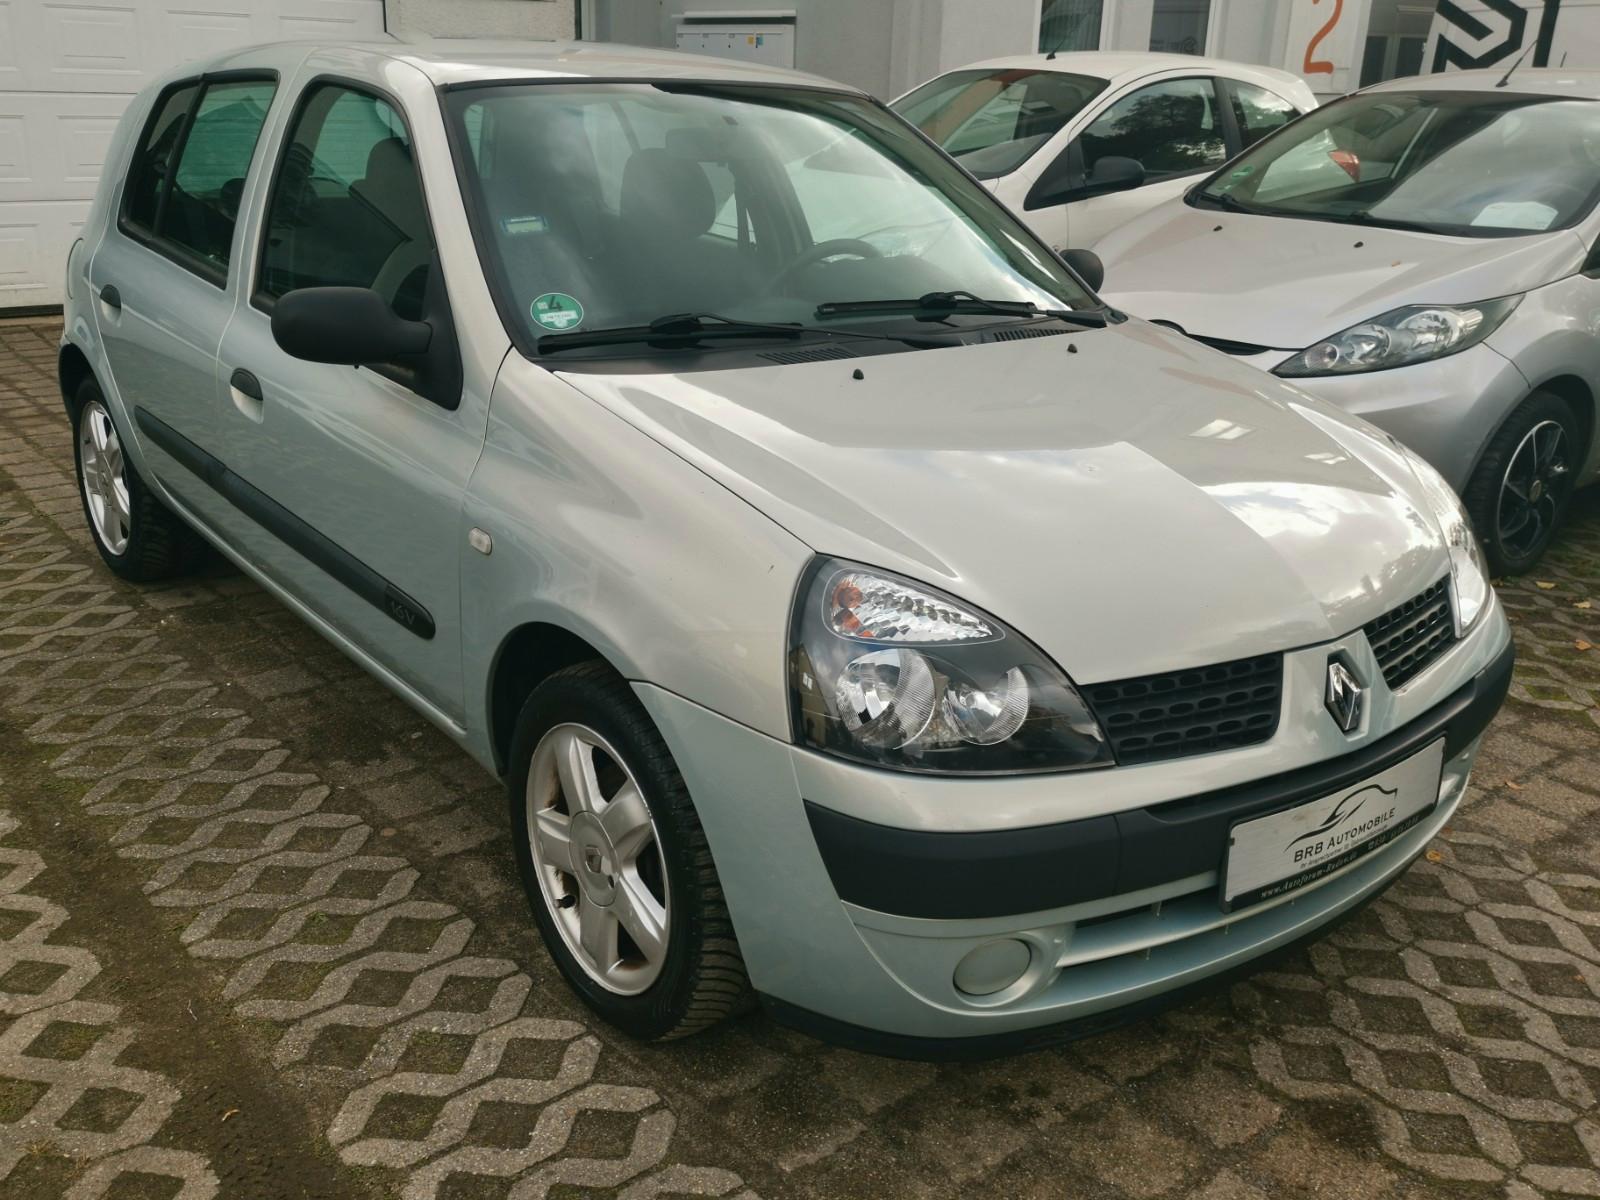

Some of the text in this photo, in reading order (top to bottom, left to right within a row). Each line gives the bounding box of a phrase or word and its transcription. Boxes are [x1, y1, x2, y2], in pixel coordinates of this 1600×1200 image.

[1303, 0, 1343, 74] 2
[548, 296, 563, 311] 4
[1294, 842, 1323, 863] BRB
[1327, 807, 1396, 850] AUTOMOBILE
